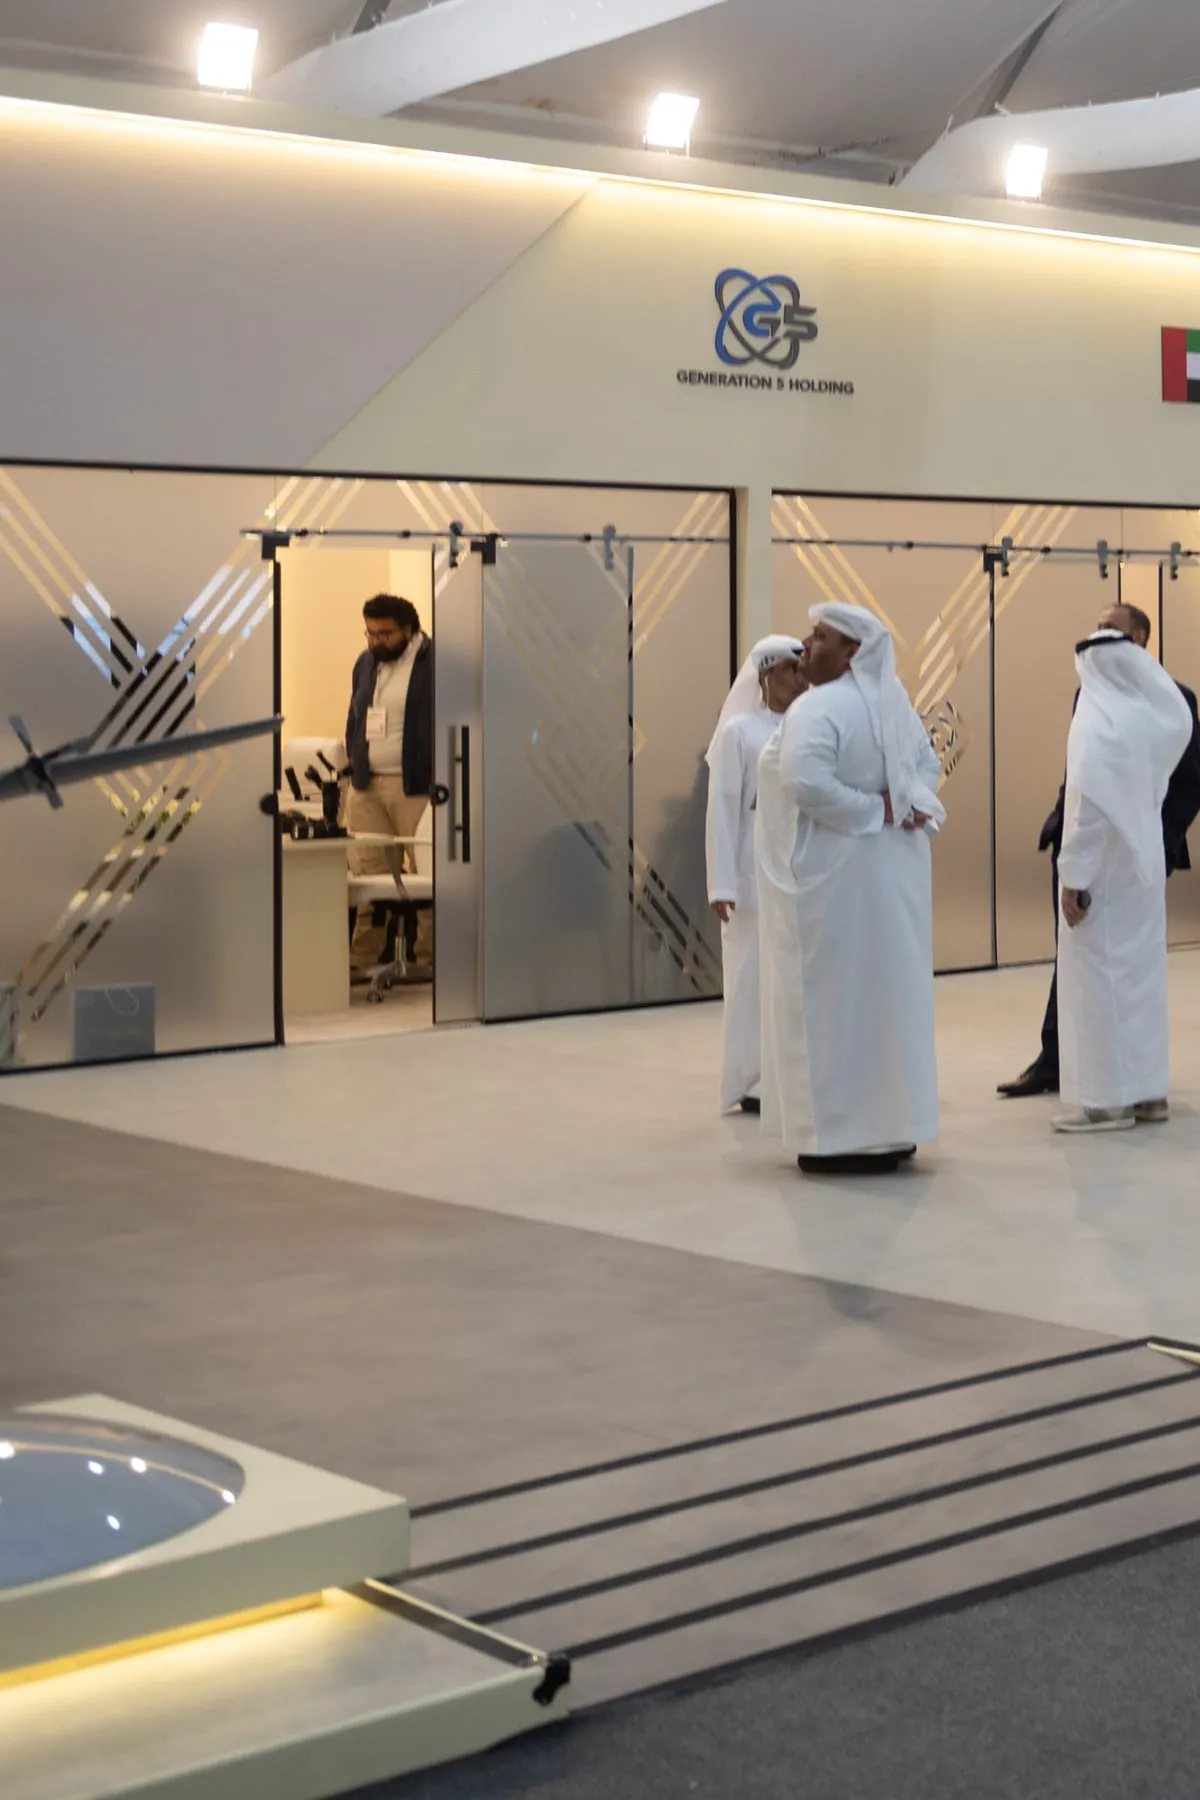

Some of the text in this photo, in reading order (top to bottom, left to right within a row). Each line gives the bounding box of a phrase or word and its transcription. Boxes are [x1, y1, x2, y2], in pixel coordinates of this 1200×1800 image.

[676, 369, 854, 395] GENERATION 5 HOLDING
